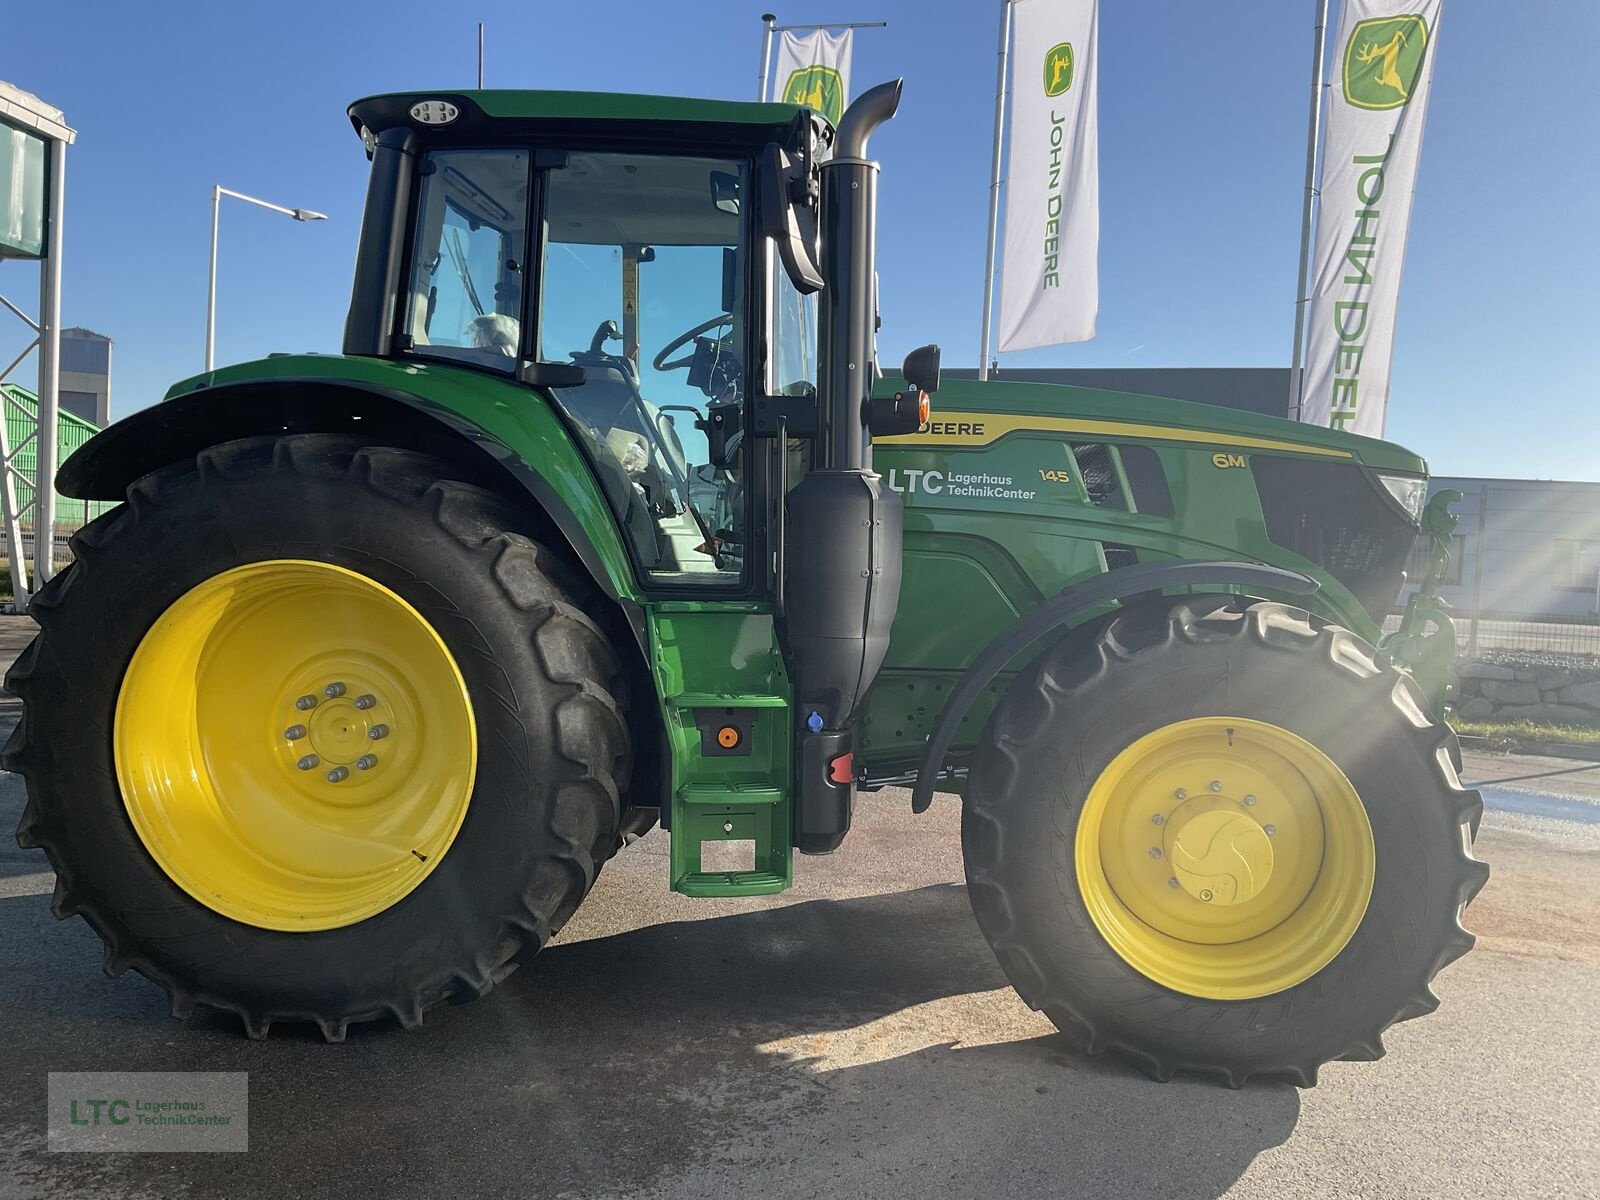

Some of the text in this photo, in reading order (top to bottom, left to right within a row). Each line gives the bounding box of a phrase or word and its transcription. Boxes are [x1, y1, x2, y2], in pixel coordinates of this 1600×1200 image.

[1043, 110, 1066, 290] JOHN DEERE
[1212, 453, 1246, 469] 6M
[888, 468, 944, 494] LTC
[947, 471, 1013, 486] Lagerhaus
[1038, 468, 1071, 484] 145
[947, 484, 1036, 500] TechnikCenter
